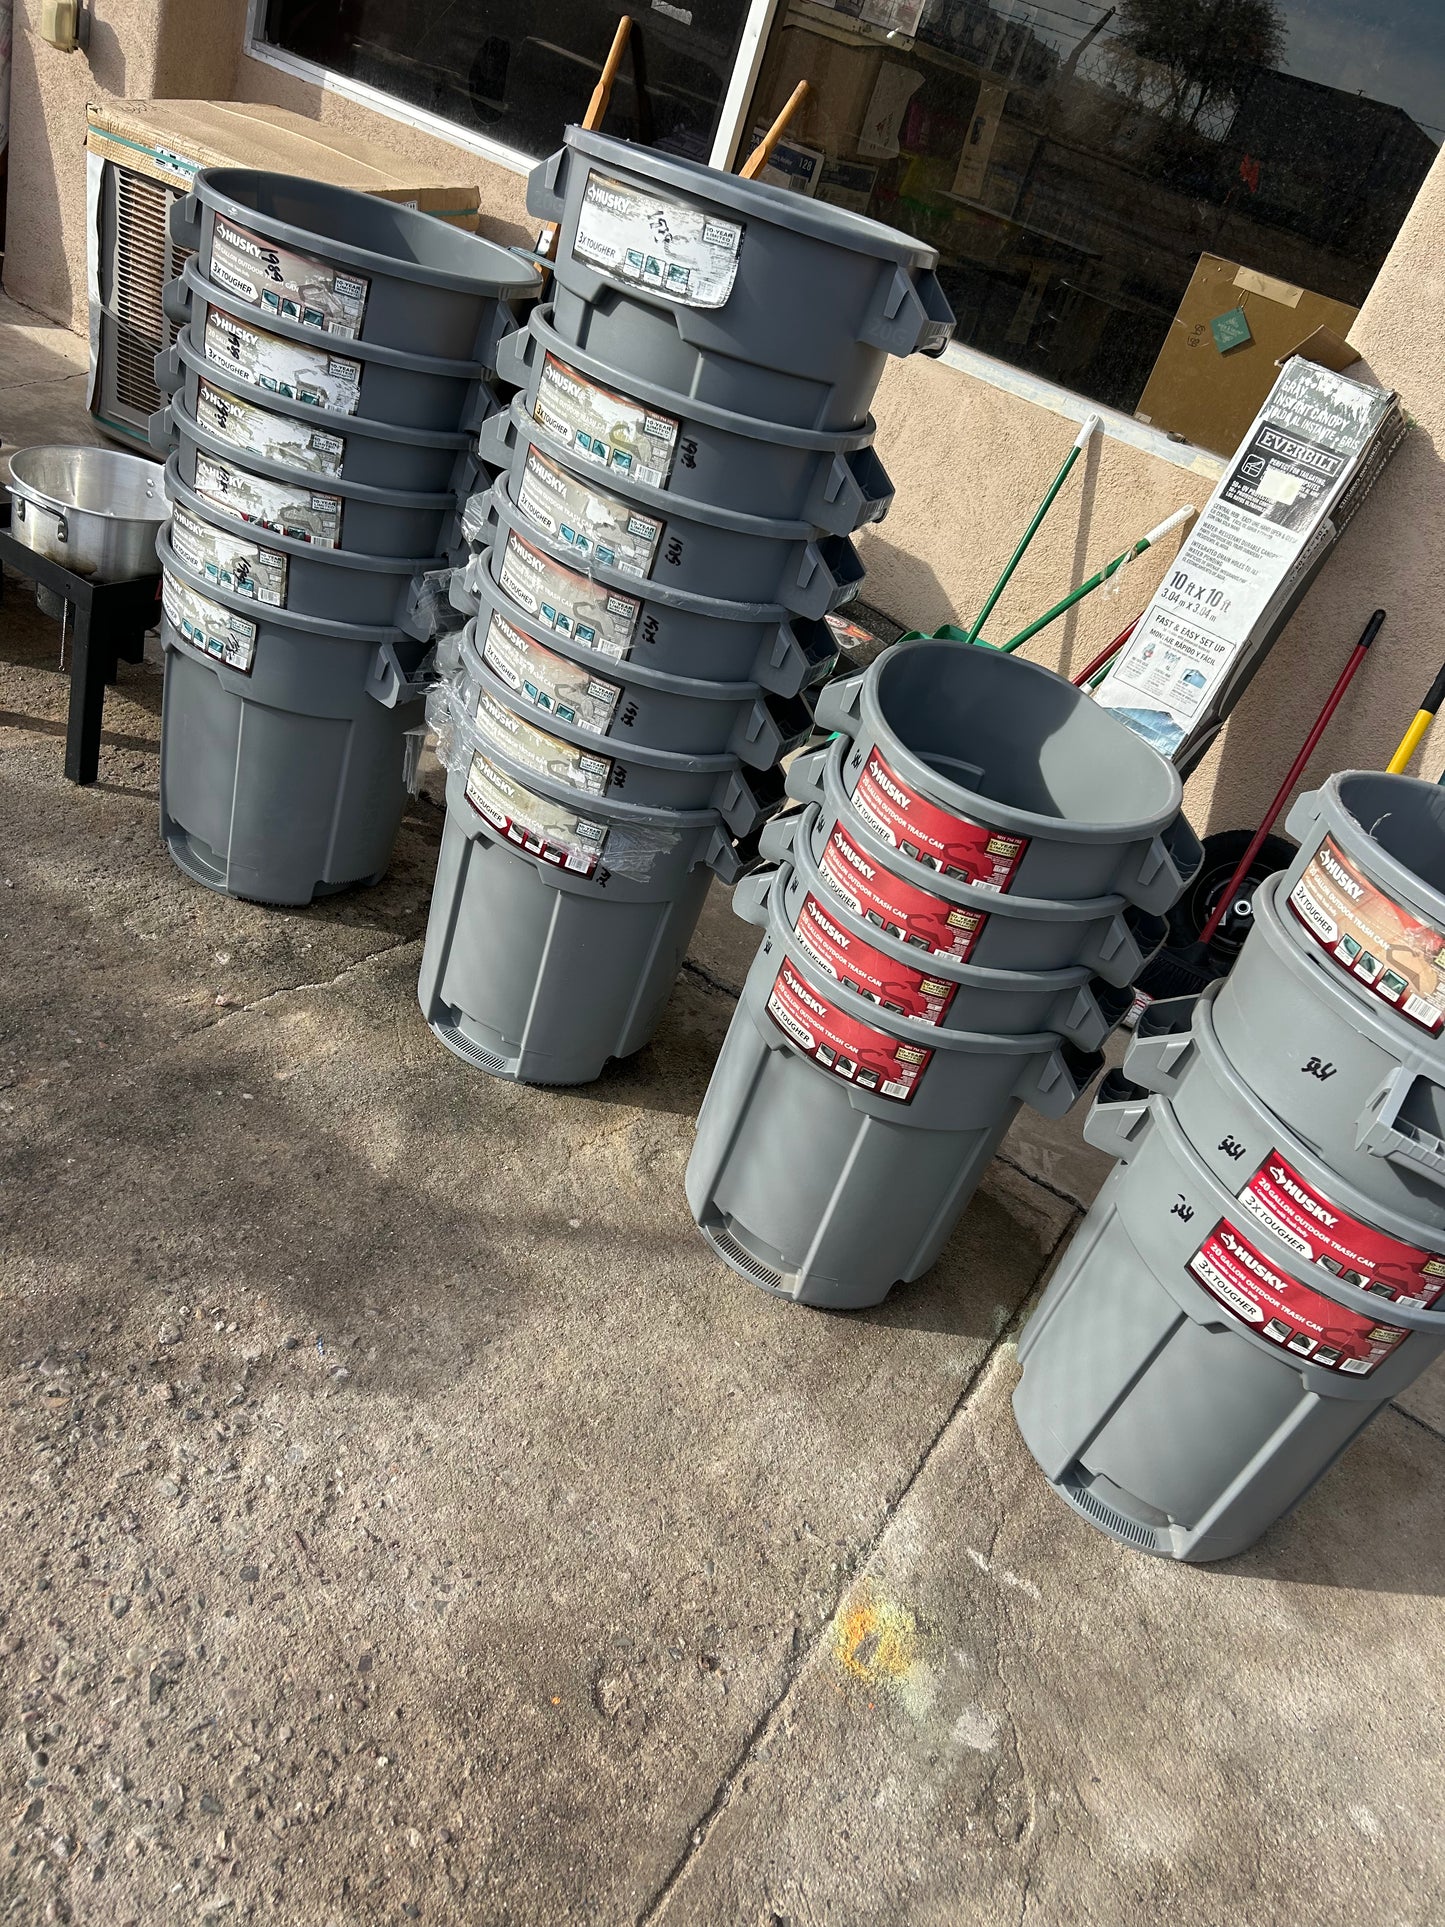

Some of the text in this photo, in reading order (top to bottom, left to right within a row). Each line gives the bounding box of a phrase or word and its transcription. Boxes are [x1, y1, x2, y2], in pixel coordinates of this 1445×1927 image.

[799, 157, 812, 172] 128
[596, 188, 629, 212] HUSKY
[226, 230, 261, 258] HUSKY
[578, 232, 615, 257] 3X TOUGHER
[706, 233, 731, 242] LIMITED
[707, 227, 733, 238] 10-YEAR
[213, 262, 252, 294] 3X TOUGHER
[238, 259, 263, 276] OUTDOOR
[221, 319, 258, 345] HUSKY
[208, 348, 249, 380] 3X TOUGHER
[552, 370, 580, 396] HUSKY
[1281, 380, 1308, 400] GRAY
[536, 405, 567, 435] 3X TOUGHER
[648, 420, 672, 430] 10-YEAR
[1273, 394, 1350, 432] INSTANT CANOPY
[1291, 417, 1300, 427] AL
[1340, 436, 1359, 450] GRIS
[1260, 432, 1339, 472] EVERBILT
[1270, 458, 1289, 471] PERFECT
[1289, 464, 1300, 475] FOR
[536, 463, 563, 492] HUSKY
[521, 493, 552, 527] 3X TOUGHER
[1213, 503, 1230, 515] CENTRAL
[180, 514, 203, 537] HUSKY
[631, 519, 654, 533] 10-YEAR
[1203, 522, 1242, 543] WATER-RESISTANT
[1241, 538, 1261, 553] DURABLE
[179, 545, 199, 566] TOUGHER
[517, 548, 545, 573] HUSKY
[1188, 547, 1203, 557] WATER
[1191, 541, 1218, 556] INTEGRATED
[1217, 552, 1232, 562] DRAIN
[1231, 559, 1246, 570] HOLES
[503, 572, 533, 605] 3X TOUGHER
[562, 598, 573, 609] CAN
[610, 598, 633, 610] 10-YEAR
[1170, 571, 1188, 590] 10
[1185, 582, 1195, 595] ft
[1205, 588, 1224, 607] 10
[1220, 600, 1231, 613] ft
[610, 603, 632, 613] LIMITED
[1161, 588, 1180, 604] 3.04
[1179, 599, 1186, 607] m
[1191, 604, 1210, 621] 3.04
[1209, 615, 1217, 623] m
[501, 624, 529, 654] HUSKY
[1156, 614, 1175, 629] FAST
[1173, 624, 1180, 632] &
[1180, 627, 1201, 640] EASY
[1200, 636, 1215, 650] SET
[1214, 644, 1226, 654] UP
[487, 645, 516, 683] 3X TOUGHER
[1174, 637, 1195, 655] RÁPIDO
[1195, 649, 1201, 657] Y
[1200, 652, 1216, 666] FÁCIL
[489, 706, 519, 735] HUSKY
[483, 767, 514, 797] HUSKY
[876, 772, 911, 808] HUSKY
[469, 785, 502, 822] 3X TOUGHER
[853, 795, 862, 810] 3X
[861, 808, 890, 841] TOUGHER
[868, 785, 883, 805] GALLON
[882, 803, 907, 828] OUTDOOR
[907, 822, 929, 841] TRASH
[928, 837, 944, 850] CAN
[990, 839, 1018, 852] 10-YEAR
[841, 846, 876, 881] HUSKY
[821, 865, 857, 910] 3X TOUGHER
[833, 853, 908, 921] GALLON OUTDOOR TRASH CAN
[1327, 859, 1363, 901] HUSKY
[951, 912, 977, 924] 10-YEAR
[1296, 885, 1333, 934] 3X TOUGHER
[1314, 873, 1391, 951] GALLON OUTDOOR TRASH CAN
[814, 912, 850, 949] HUSKY
[807, 921, 823, 943] GALLON
[822, 940, 847, 966] OUTDOOR
[847, 961, 868, 979] TRASH
[867, 975, 882, 987] CAN
[791, 980, 827, 1016] HUSKY
[923, 981, 950, 994] 10-YEAR
[772, 1000, 810, 1042] 3X TOUGHER
[783, 990, 859, 1054] GALLON OUTDOOR TRASH CAN
[898, 1048, 925, 1060] 10-YEAR
[1257, 1188, 1309, 1238] Compatible with Trash Dolly
[1283, 1179, 1338, 1226] HUSKY
[1244, 1195, 1306, 1252] 3X TOUGHER
[1258, 1178, 1376, 1269] 20 GALLON OUTDOOR TRASH CAN
[1209, 1253, 1260, 1302] Compatible with Trash Dolly
[1233, 1246, 1288, 1291] HUSKY
[1197, 1259, 1257, 1316] 3X TOUGHER
[1209, 1243, 1324, 1332] 20 GALLON OUTDOOR TRASH CAN
